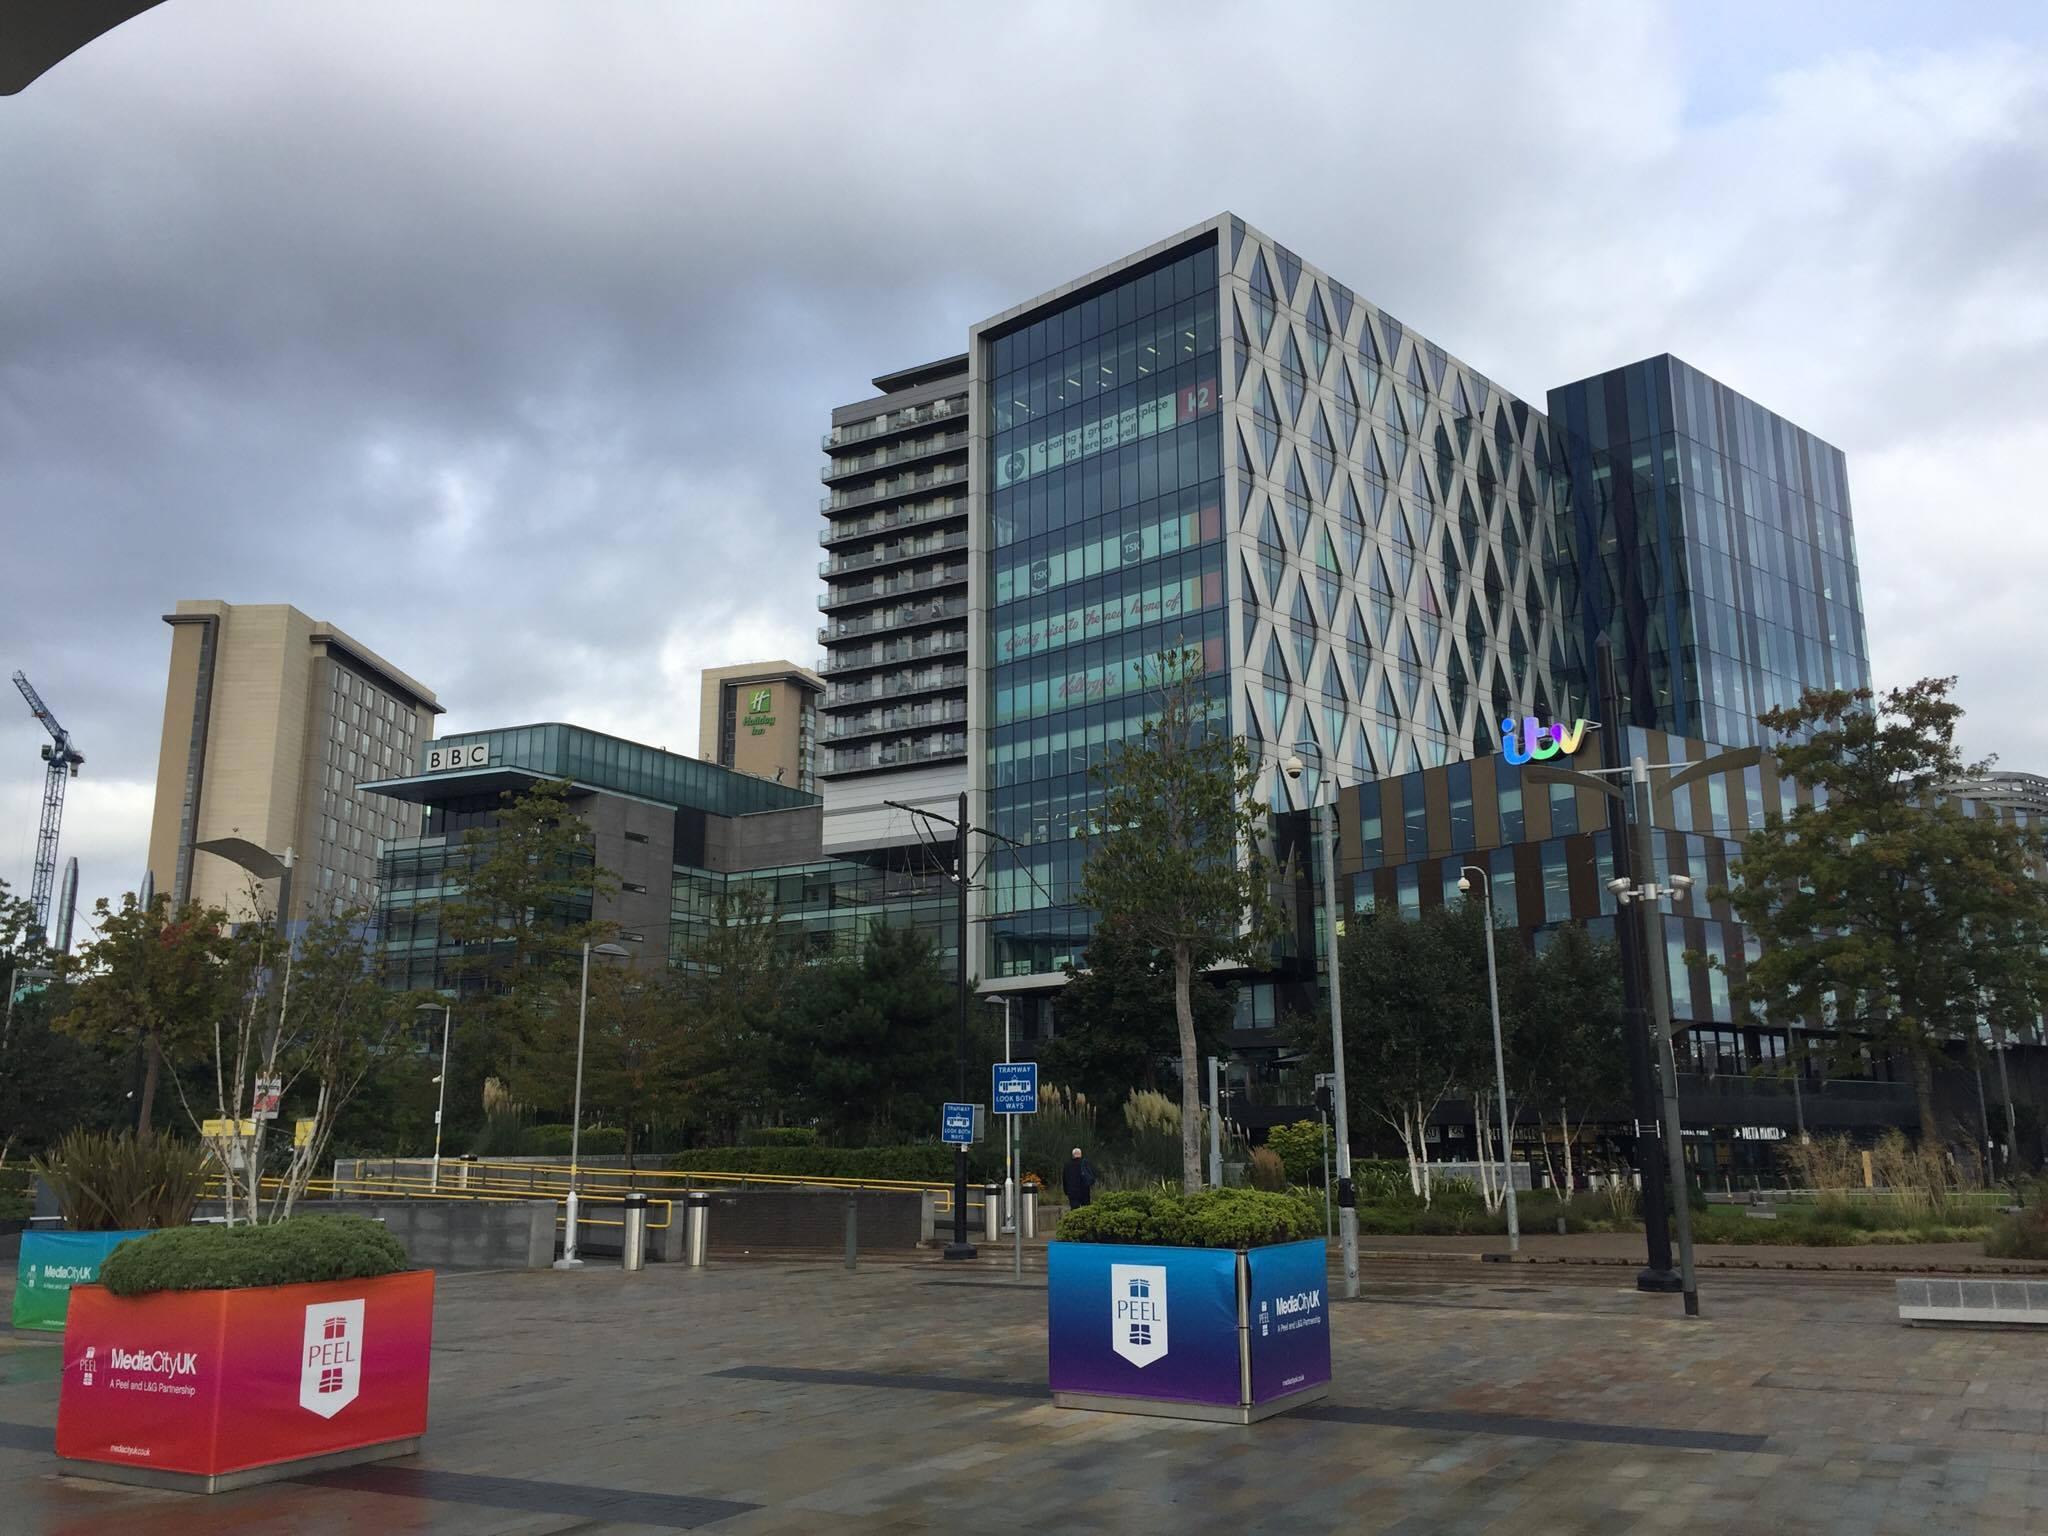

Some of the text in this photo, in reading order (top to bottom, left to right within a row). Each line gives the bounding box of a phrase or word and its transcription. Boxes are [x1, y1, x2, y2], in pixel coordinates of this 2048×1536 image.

[1188, 387, 1209, 413] H2
[1125, 542, 1140, 553] TSK
[1033, 569, 1048, 580] TSK
[430, 746, 485, 769] BBC
[1005, 1102, 1024, 1110] WAYS
[44, 1265, 91, 1281] MediaCityUK
[1117, 1300, 1161, 1322] PEEL
[1276, 1290, 1320, 1315] MediaCityUK
[111, 1348, 198, 1379] MediaCityUK
[307, 1340, 355, 1368] PEEL
[79, 1359, 97, 1372] PEEL
[109, 1379, 196, 1397] A Peel and L&G Partnership
